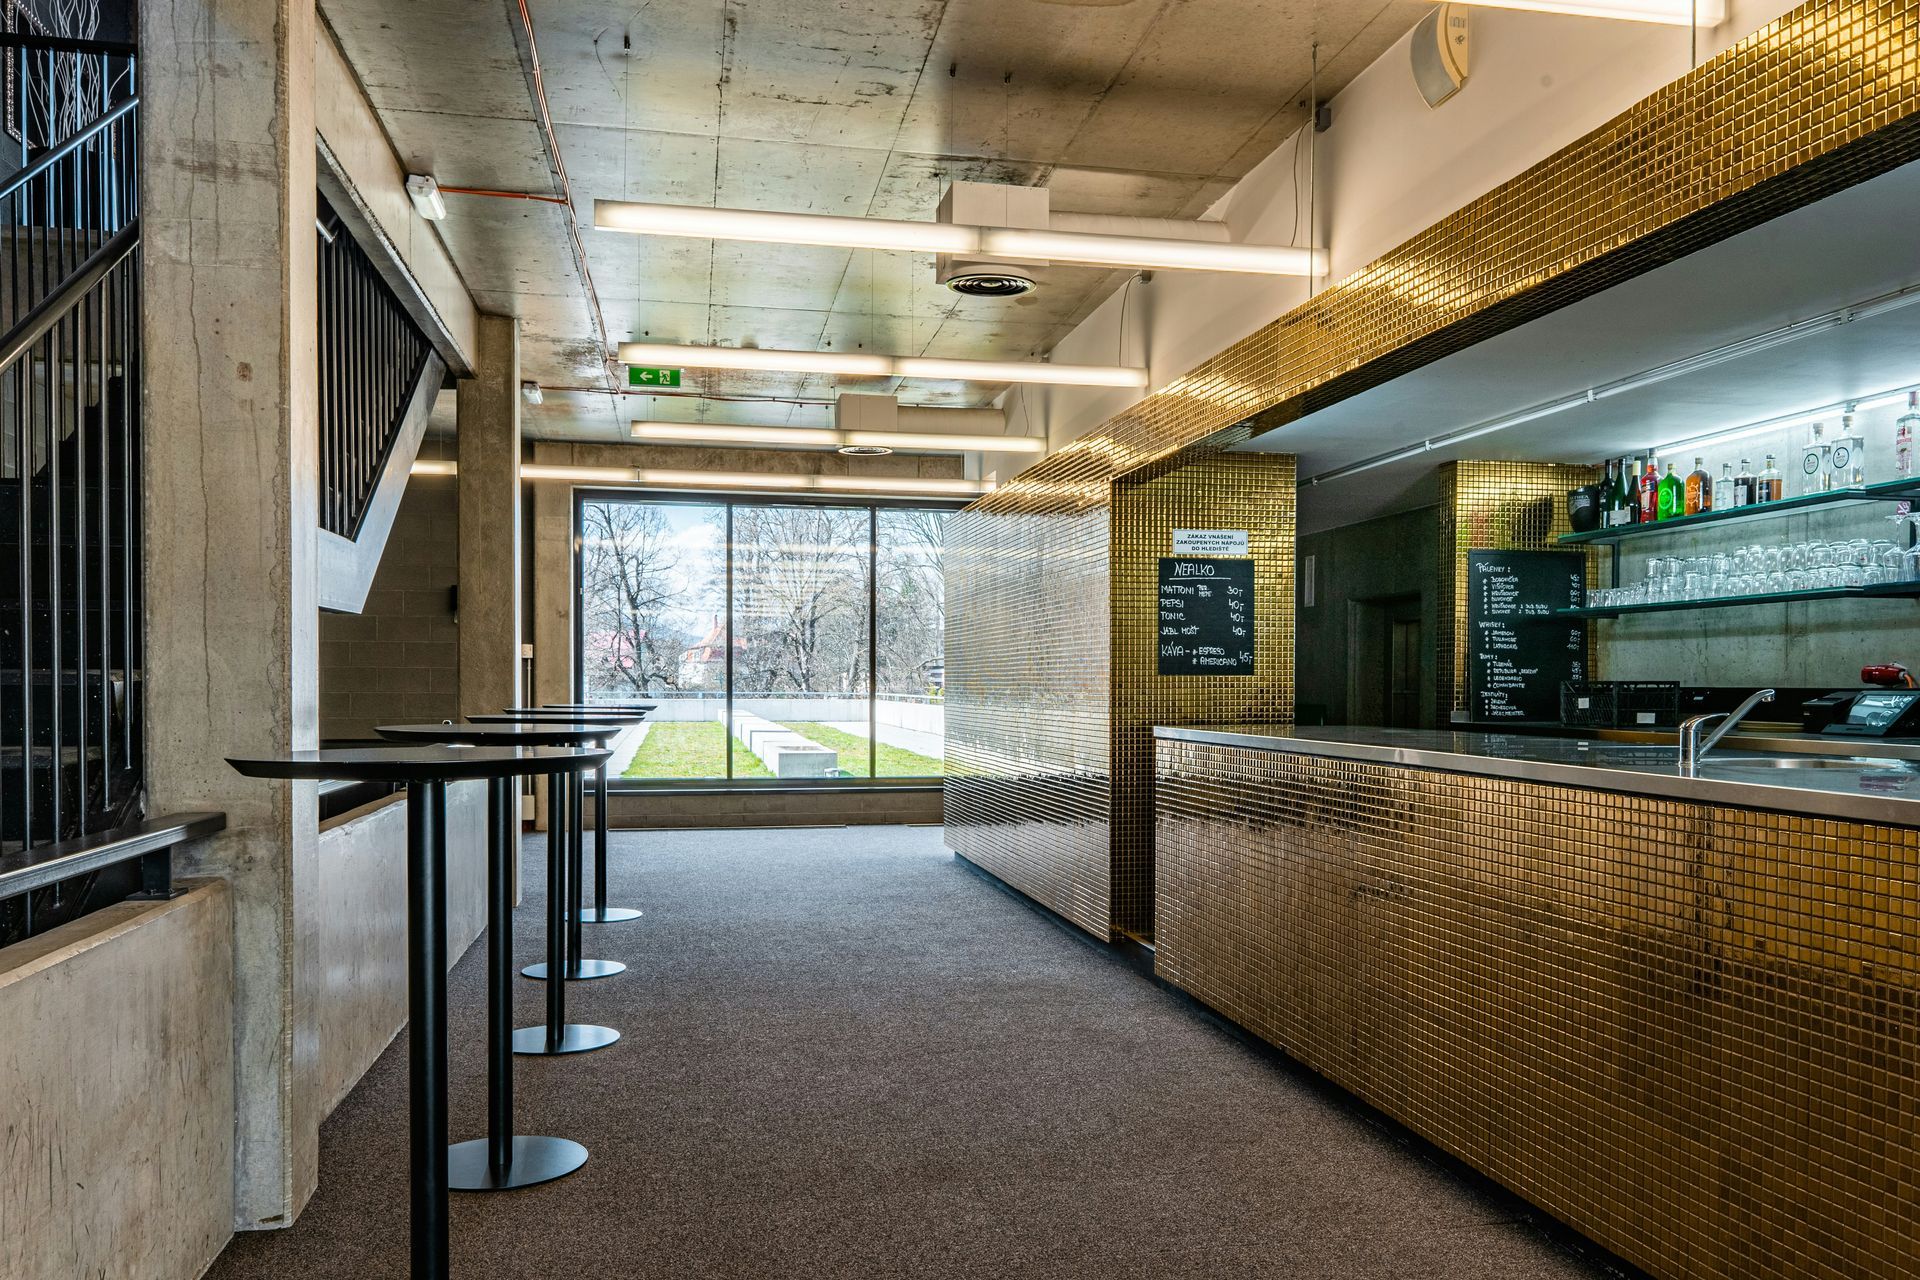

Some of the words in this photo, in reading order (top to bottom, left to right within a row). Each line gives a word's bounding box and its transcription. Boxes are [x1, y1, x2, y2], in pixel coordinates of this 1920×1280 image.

[1174, 562, 1214, 576] NEALKO
[1161, 585, 1194, 594] MATTONI
[1160, 599, 1184, 608] PEPSI
[1160, 612, 1185, 620] TONIC
[1161, 641, 1183, 657] KÁVA
[1200, 657, 1237, 666] AMERICANO
